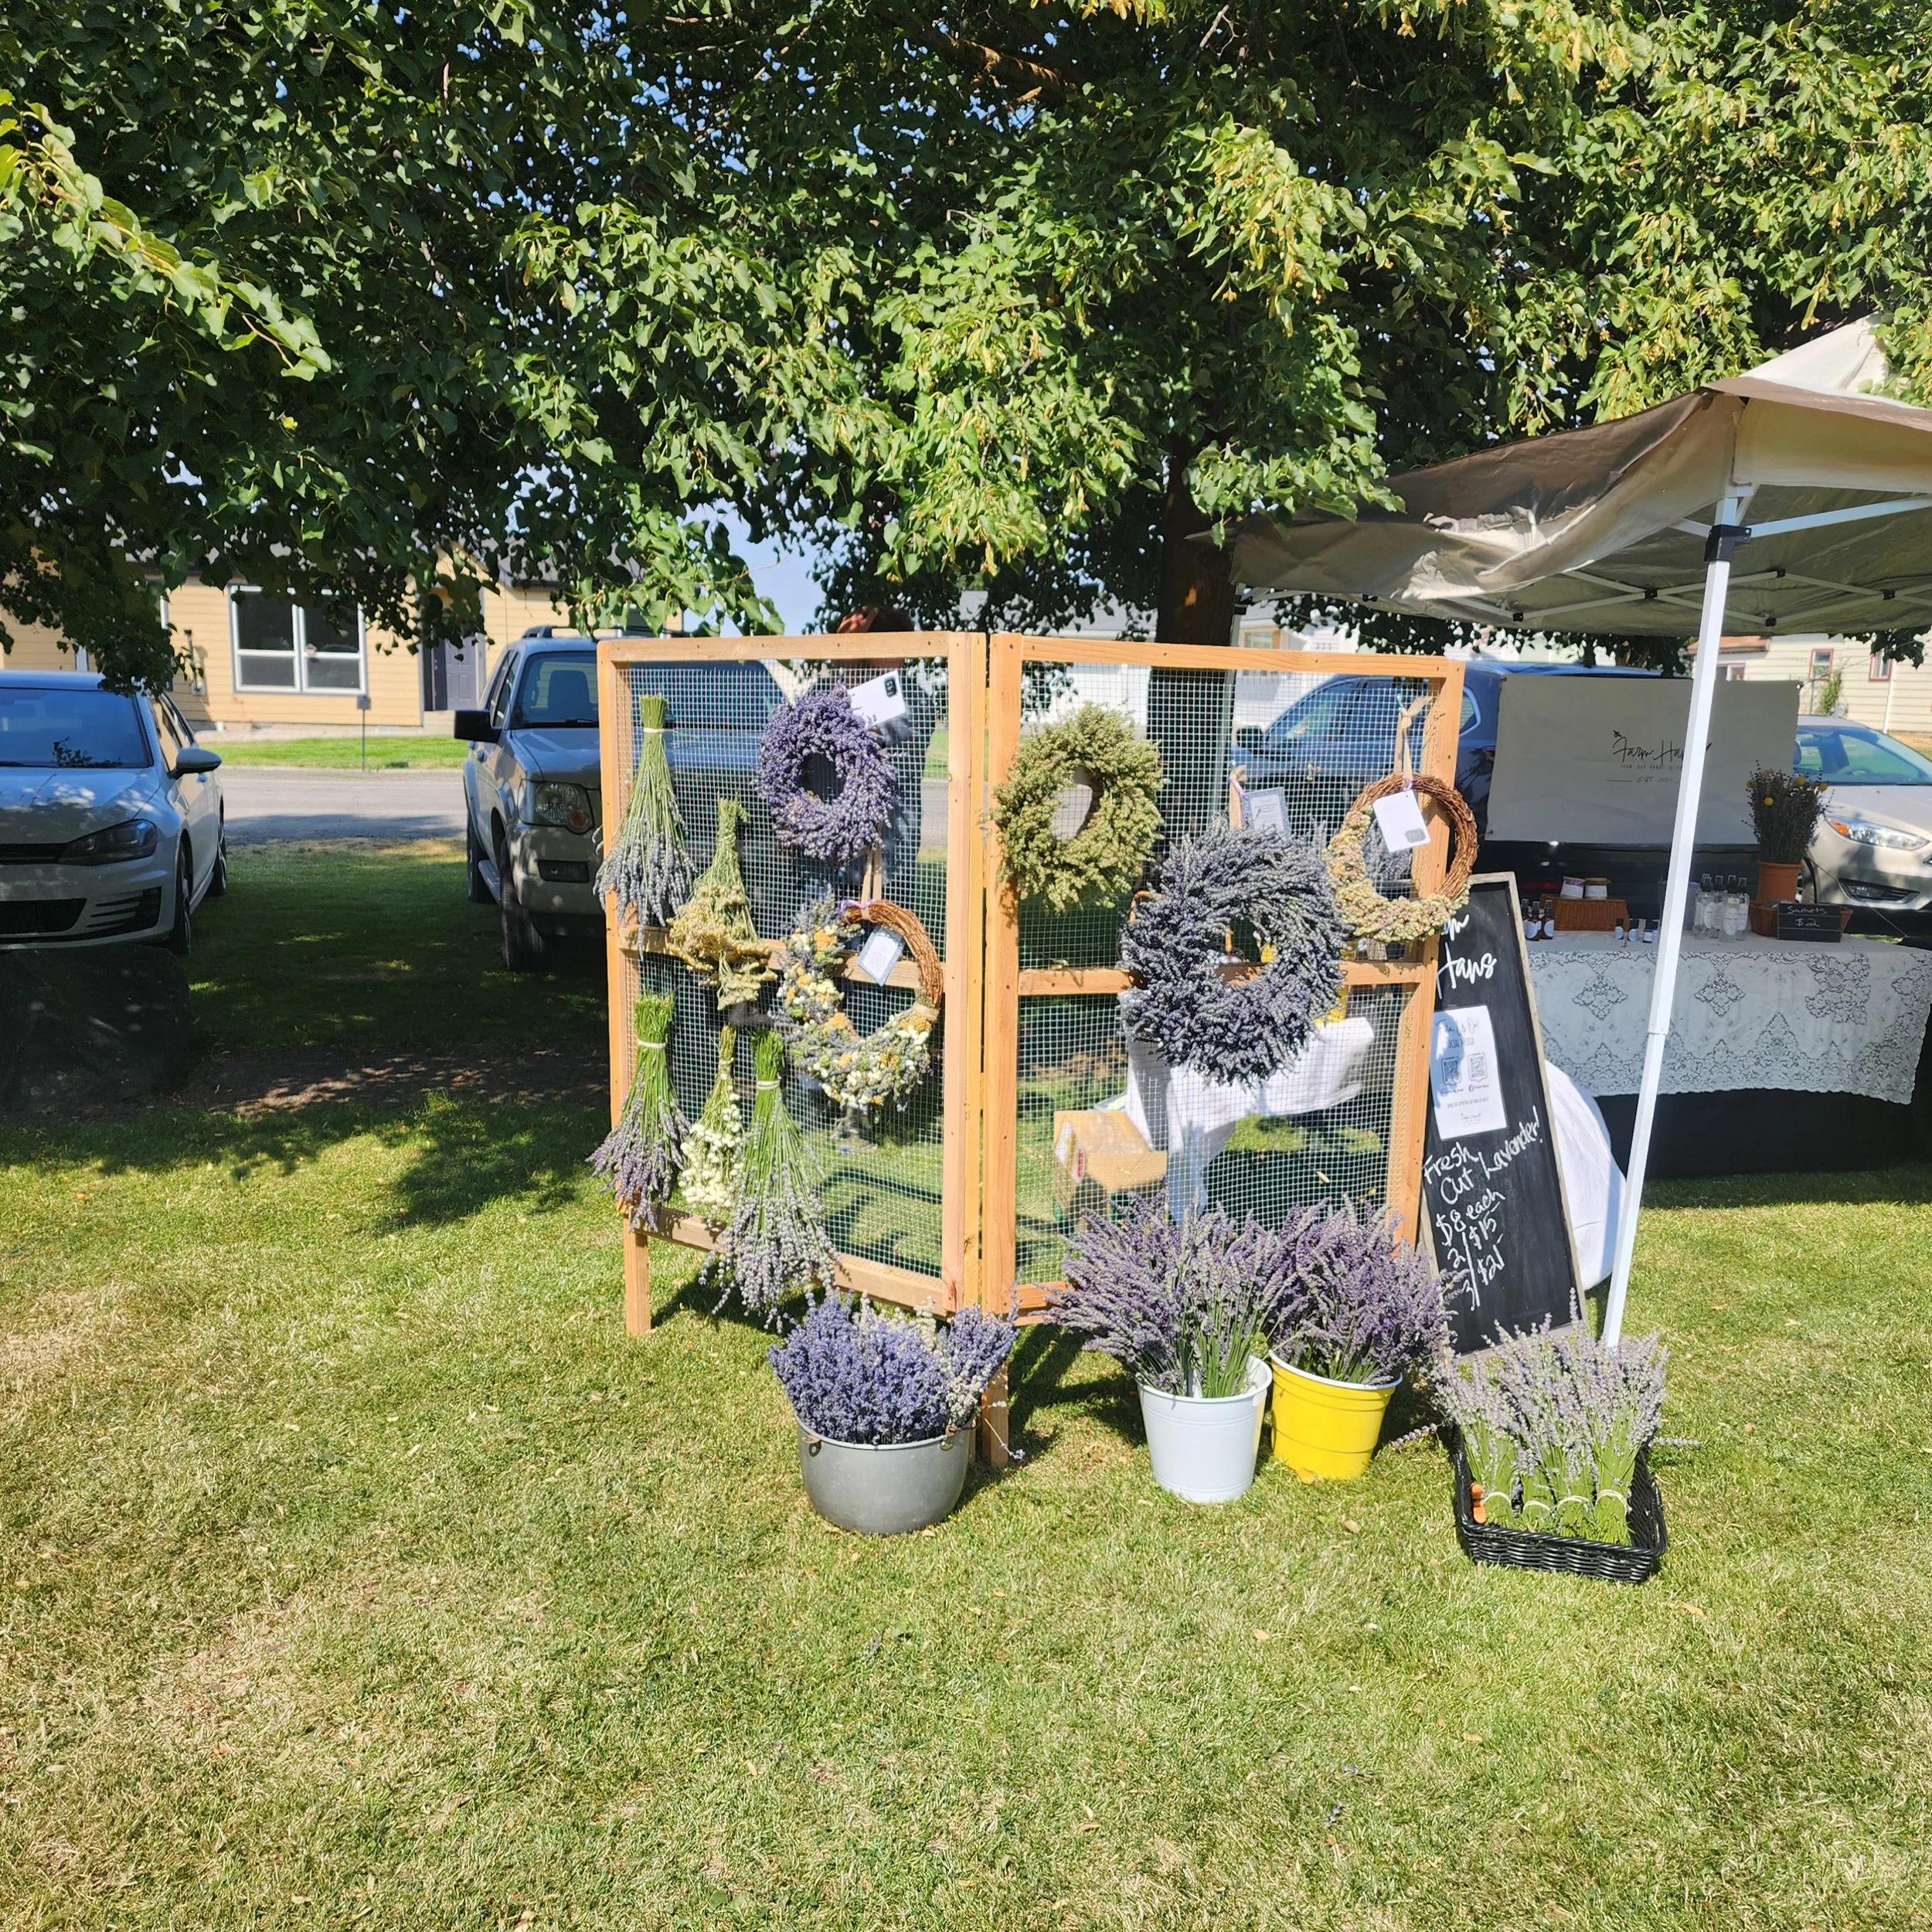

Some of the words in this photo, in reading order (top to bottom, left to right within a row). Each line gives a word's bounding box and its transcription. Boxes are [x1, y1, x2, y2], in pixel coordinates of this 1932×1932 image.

[1612, 736, 1654, 763] Farm
[1787, 905, 1827, 915] Sachets
[1795, 917, 1821, 927] $2
[1422, 1141, 1479, 1185] Fresh
[1440, 1166, 1475, 1205] Cut
[1478, 1105, 1543, 1180] Lavender!
[1436, 1209, 1467, 1247] $8
[1465, 1188, 1506, 1220] each
